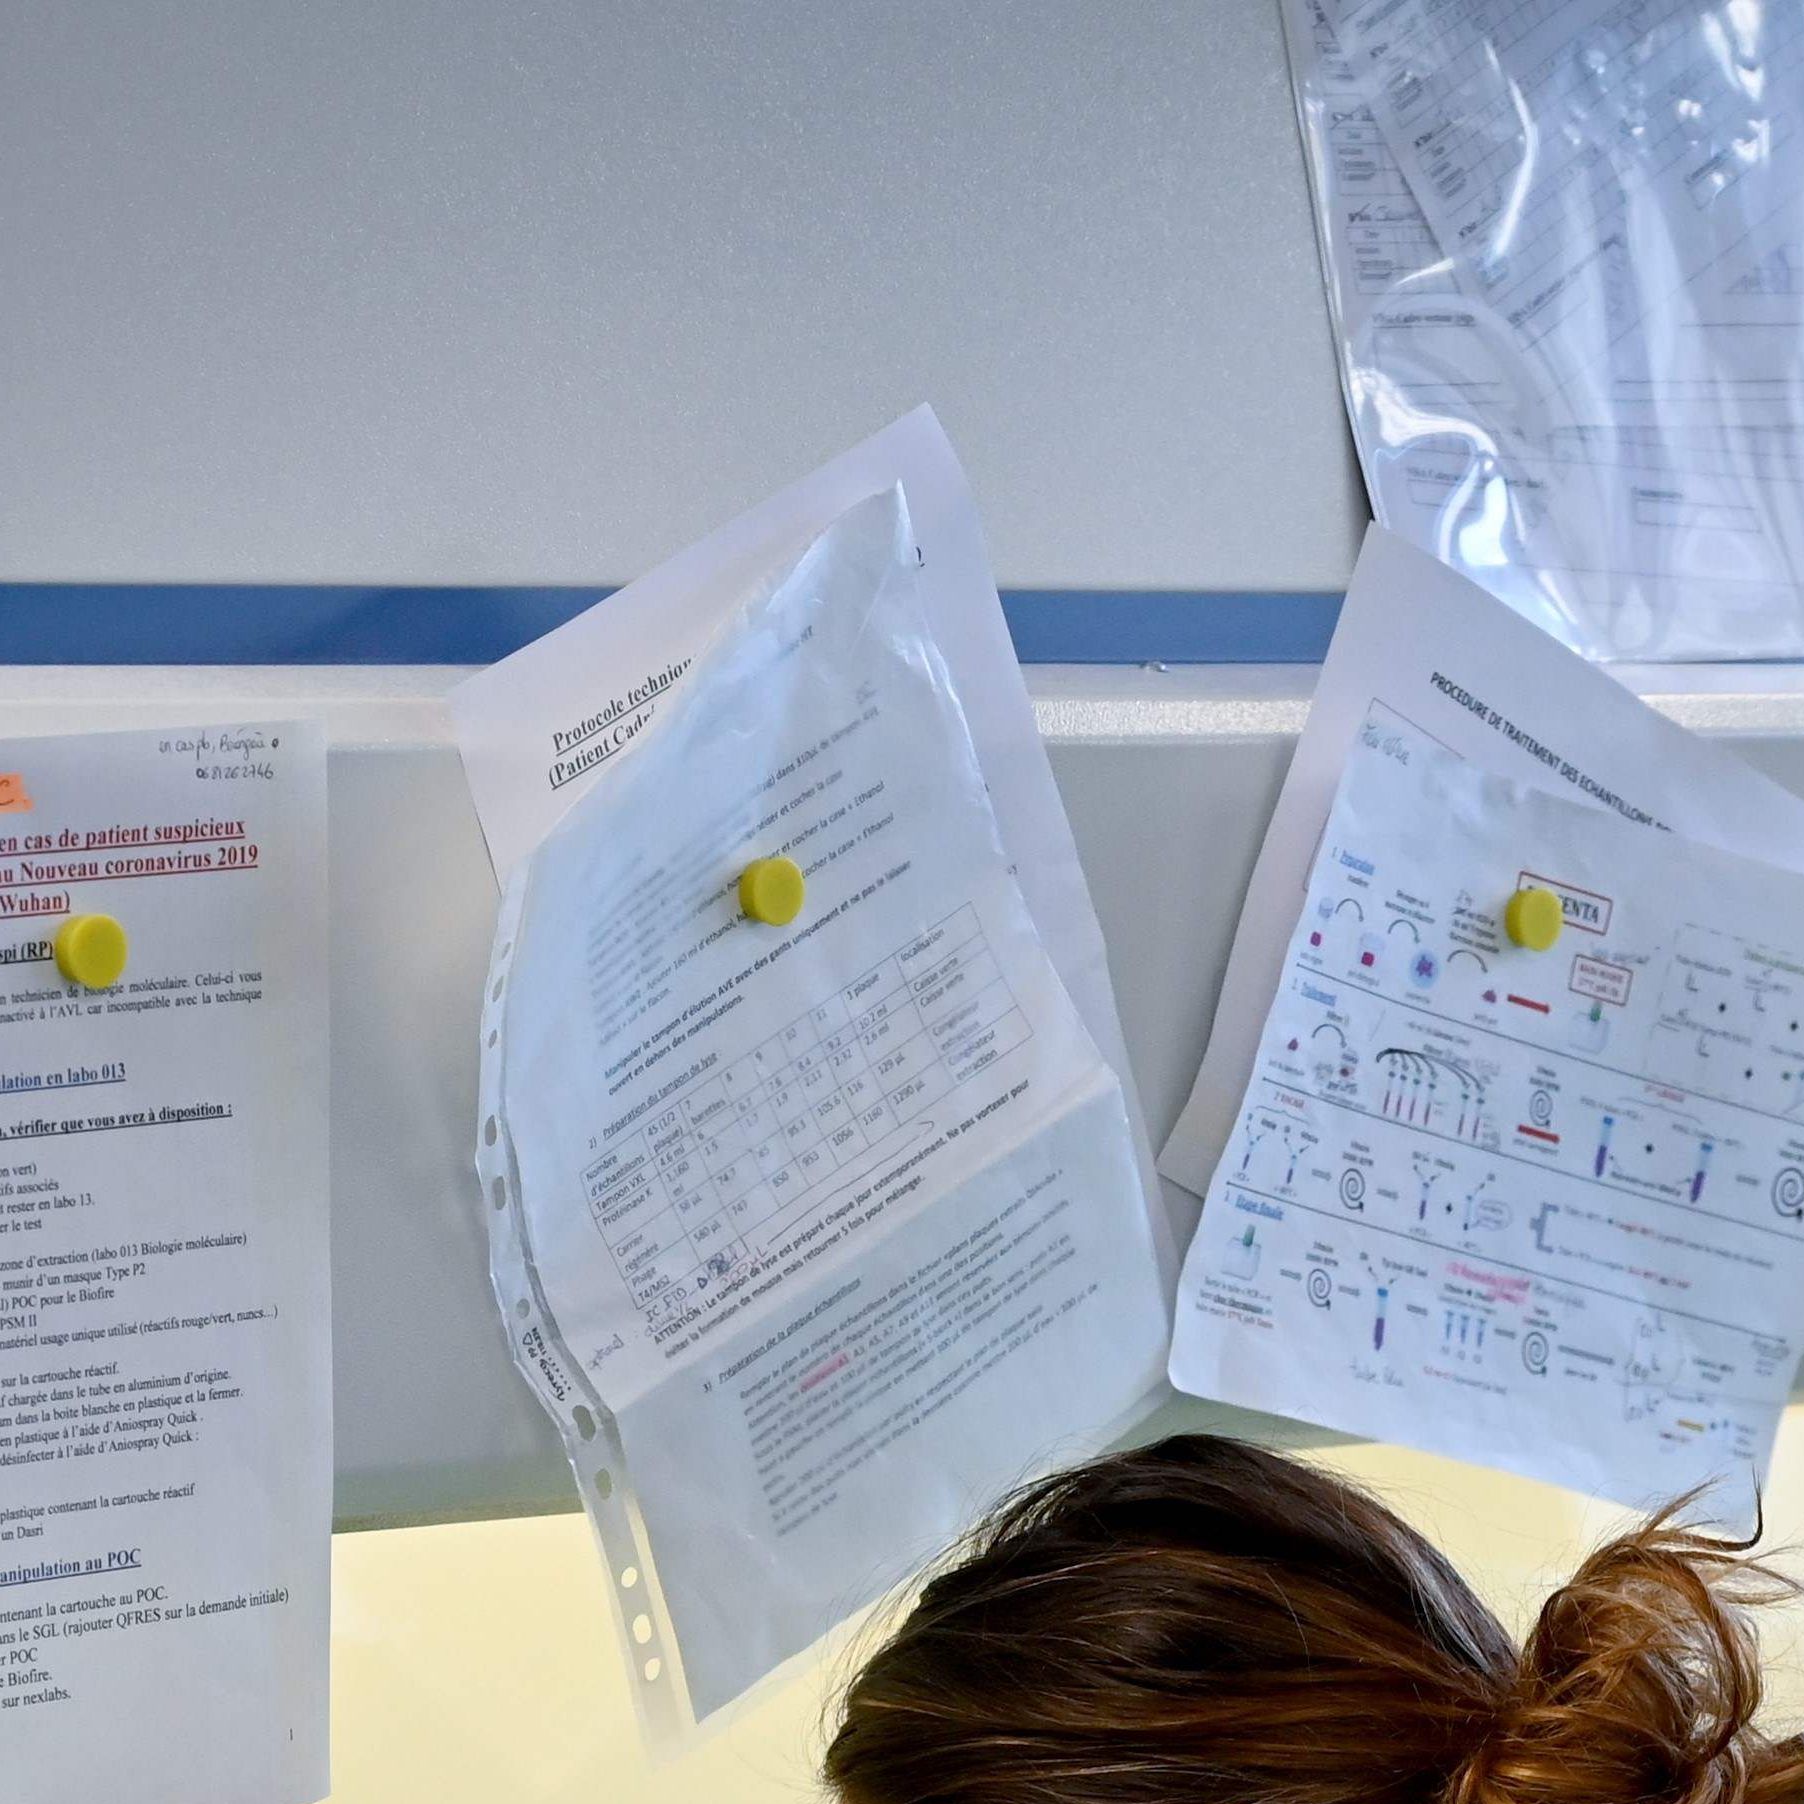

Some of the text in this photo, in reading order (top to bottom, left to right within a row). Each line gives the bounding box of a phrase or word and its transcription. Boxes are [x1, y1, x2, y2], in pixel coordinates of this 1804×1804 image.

[553, 699, 624, 752] Protocole
[1430, 672, 1489, 720] PROCEDURE
[1487, 711, 1503, 730] DE
[1502, 720, 1561, 769] TRAITEMENT
[1560, 762, 1580, 784] DES
[548, 731, 610, 790] (Patient
[0, 817, 245, 852] en cas de patient suspicieux
[20, 844, 258, 881] Nouveau coronavirus 2019
[21, 941, 54, 960] (RP)
[634, 1064, 644, 1076] en
[645, 1045, 671, 1068] dehors
[672, 1033, 686, 1048] des
[44, 1073, 64, 1088] en
[67, 1066, 99, 1083] labo
[102, 1062, 126, 1080] 013
[10, 1102, 224, 1135] vérifier que vous avez à disposition
[0, 1260, 24, 1272] zone
[119, 1243, 138, 1258] 013
[141, 1239, 183, 1256] Biologie
[185, 1232, 247, 1250] moléculaire)
[654, 1307, 702, 1345] ATTENTION
[705, 1298, 717, 1309] Le
[749, 1265, 761, 1278] de
[779, 1244, 793, 1258] est
[792, 1219, 825, 1251] préparé
[825, 1201, 855, 1225] chaque
[853, 1188, 872, 1207] jour
[63, 1270, 102, 1285] masque
[105, 1266, 130, 1281] Type
[133, 1262, 146, 1276] P2
[11, 1286, 115, 1310] POC pour le Biofire
[40, 1333, 69, 1347] usage
[71, 1328, 106, 1343] unique
[107, 1321, 138, 1337] utilisé
[1, 1377, 17, 1388] sur
[19, 1373, 30, 1386] la
[31, 1367, 82, 1384] cartouche
[7, 1390, 48, 1408] chargée
[50, 1388, 74, 1401] dans
[76, 1385, 86, 1399] le
[89, 1383, 111, 1397] tube
[113, 1384, 126, 1394] en
[128, 1374, 182, 1392] aluminium
[15, 1412, 39, 1425] dans
[41, 1409, 51, 1423] la
[81, 1400, 121, 1417] blanche
[123, 1402, 135, 1412] en
[138, 1394, 182, 1413] plastique
[184, 1392, 194, 1404] et
[196, 1389, 206, 1402] la
[14, 1430, 60, 1449] plastique
[62, 1426, 69, 1439] à
[167, 1410, 197, 1427] Quick
[47, 1482, 196, 1515] contenant la cartouche réactif
[83, 1558, 103, 1573] au
[106, 1548, 142, 1570] POC
[19, 1587, 289, 1642] le SGL (rajouter QFRES sur la demande initiale)
[46, 1586, 168, 1617] la cartouche au POC.
[8, 1668, 52, 1687] Biofire.
[1, 1696, 20, 1709] sur
